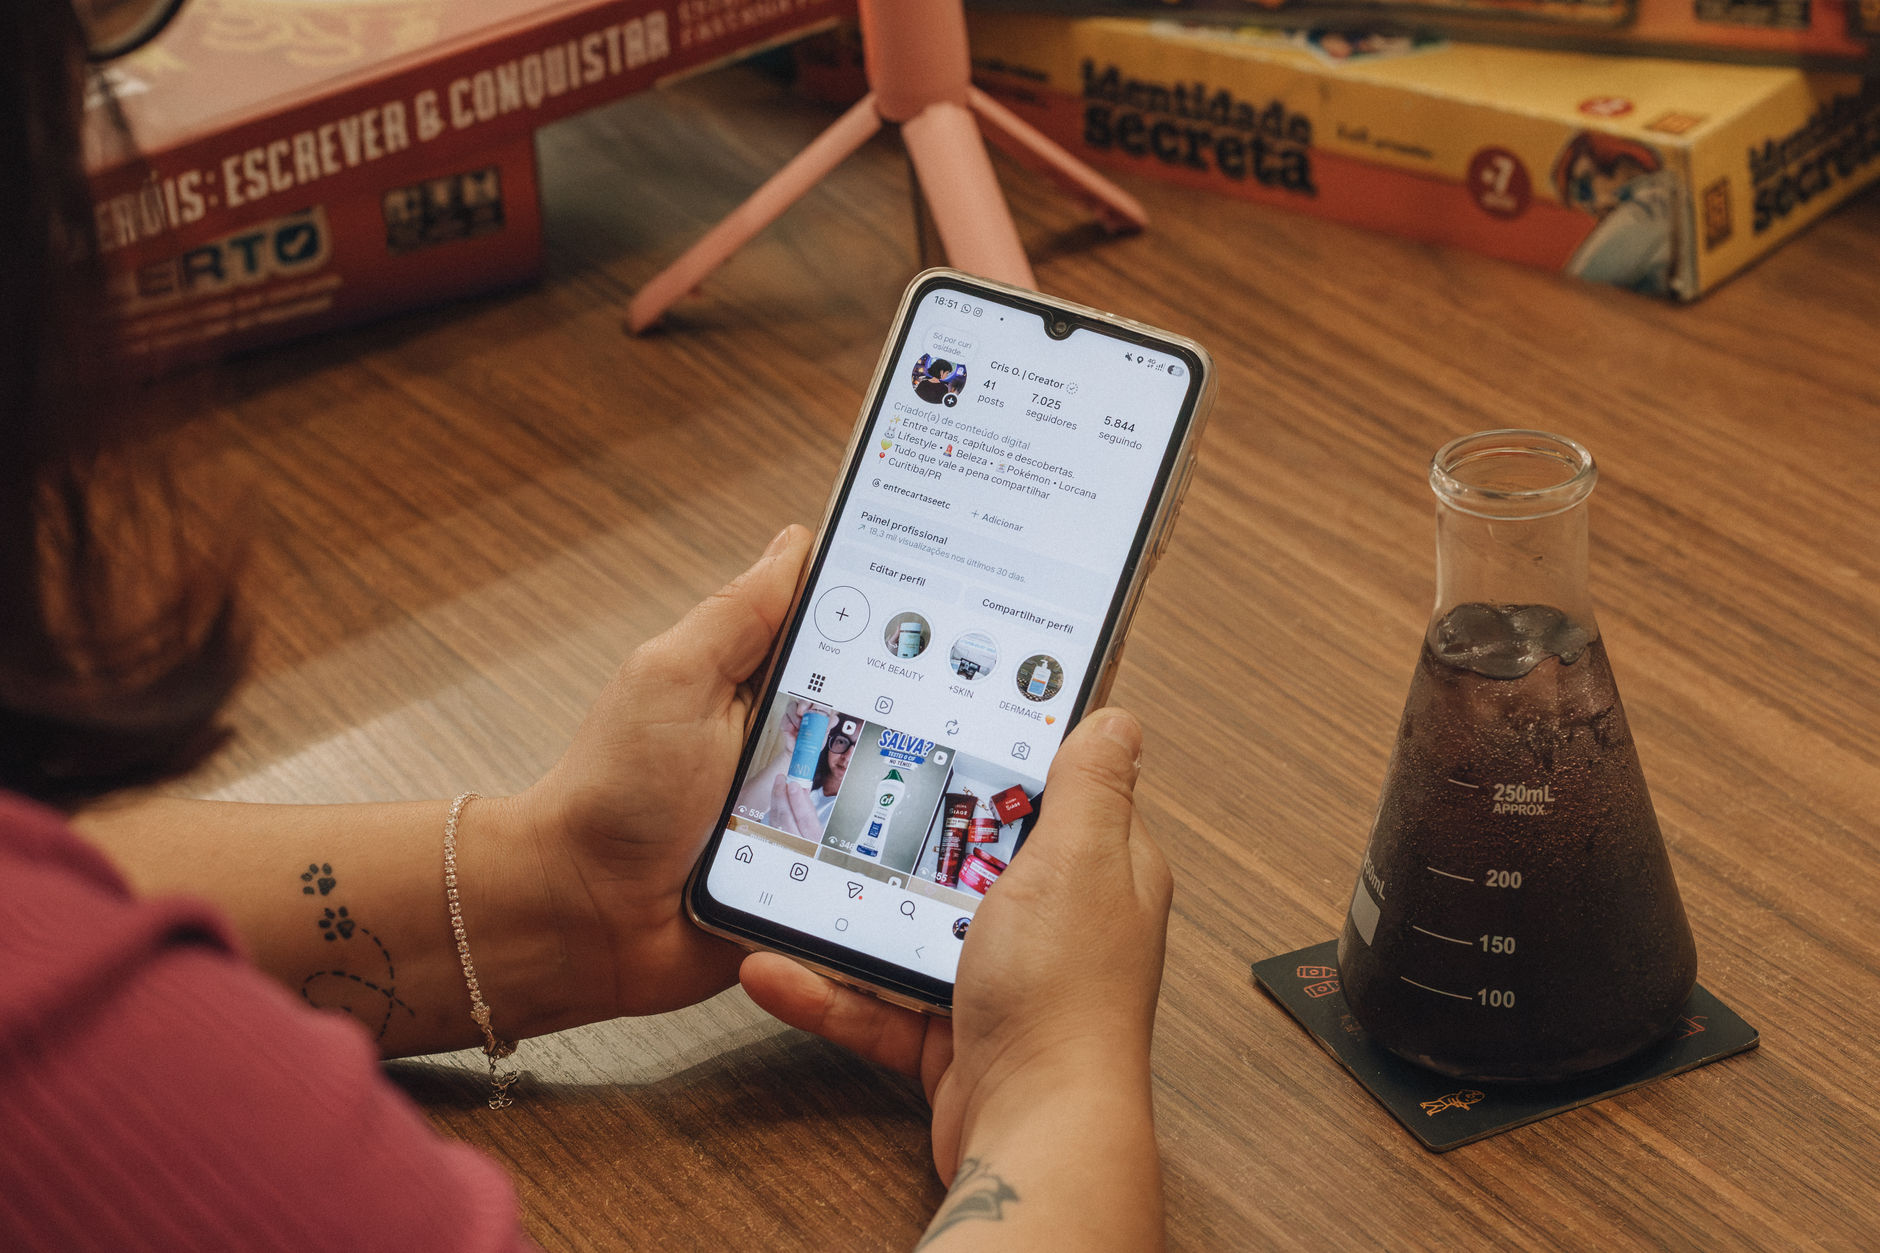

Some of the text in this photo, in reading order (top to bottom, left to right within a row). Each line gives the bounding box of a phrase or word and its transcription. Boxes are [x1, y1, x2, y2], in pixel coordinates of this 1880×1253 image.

[221, 100, 409, 208] ESCREVER
[415, 89, 447, 143] &
[448, 10, 671, 131] CONQUISTAR
[1084, 104, 1317, 197] secreta
[934, 295, 959, 310] 18:51
[932, 331, 973, 350] Só por curi
[983, 379, 997, 391] 41
[990, 360, 1010, 373] Cris
[1011, 367, 1021, 377] O.
[1027, 372, 1065, 390] Creator
[977, 394, 1005, 408] posts
[1031, 393, 1063, 411] 7.025
[893, 401, 1031, 451] Criador(a) de conteúdo digital
[1025, 408, 1078, 431] seguidores
[1103, 415, 1136, 433] 5.844
[902, 418, 1076, 479] Entre cartas, capítulos e descobertas.
[1098, 430, 1143, 451] seguindo
[888, 457, 942, 480] Curitiba/PR
[894, 444, 917, 458] Tudo
[918, 453, 937, 466] que
[938, 459, 958, 471] vale
[965, 468, 990, 482] pena
[990, 475, 1051, 500] compartilhar
[897, 431, 1098, 500] Lifestyle Beleza Pokémon Lorcana
[883, 483, 952, 509] entrecartaseetc
[860, 511, 949, 546] Painel profissional
[981, 513, 1025, 532] Adicionar
[869, 526, 1027, 584] 18,3 mil visualizações nos últimos 30 dias.
[869, 562, 927, 588] Editar perfil
[982, 598, 1074, 635] Compartilhar perfil
[818, 641, 841, 656] Novo
[867, 656, 925, 682] VICK BEAUTY
[949, 685, 975, 699] +SKIN
[999, 700, 1044, 722] DERMAGE
[879, 729, 935, 757] SALVA?
[880, 794, 894, 806] Cif
[1493, 783, 1555, 802] 250mL
[749, 808, 765, 820] 536
[839, 839, 856, 851] 346
[931, 871, 948, 883] 455
[1486, 869, 1522, 889] 200
[1480, 934, 1516, 955] 150
[1478, 988, 1516, 1009] 100
